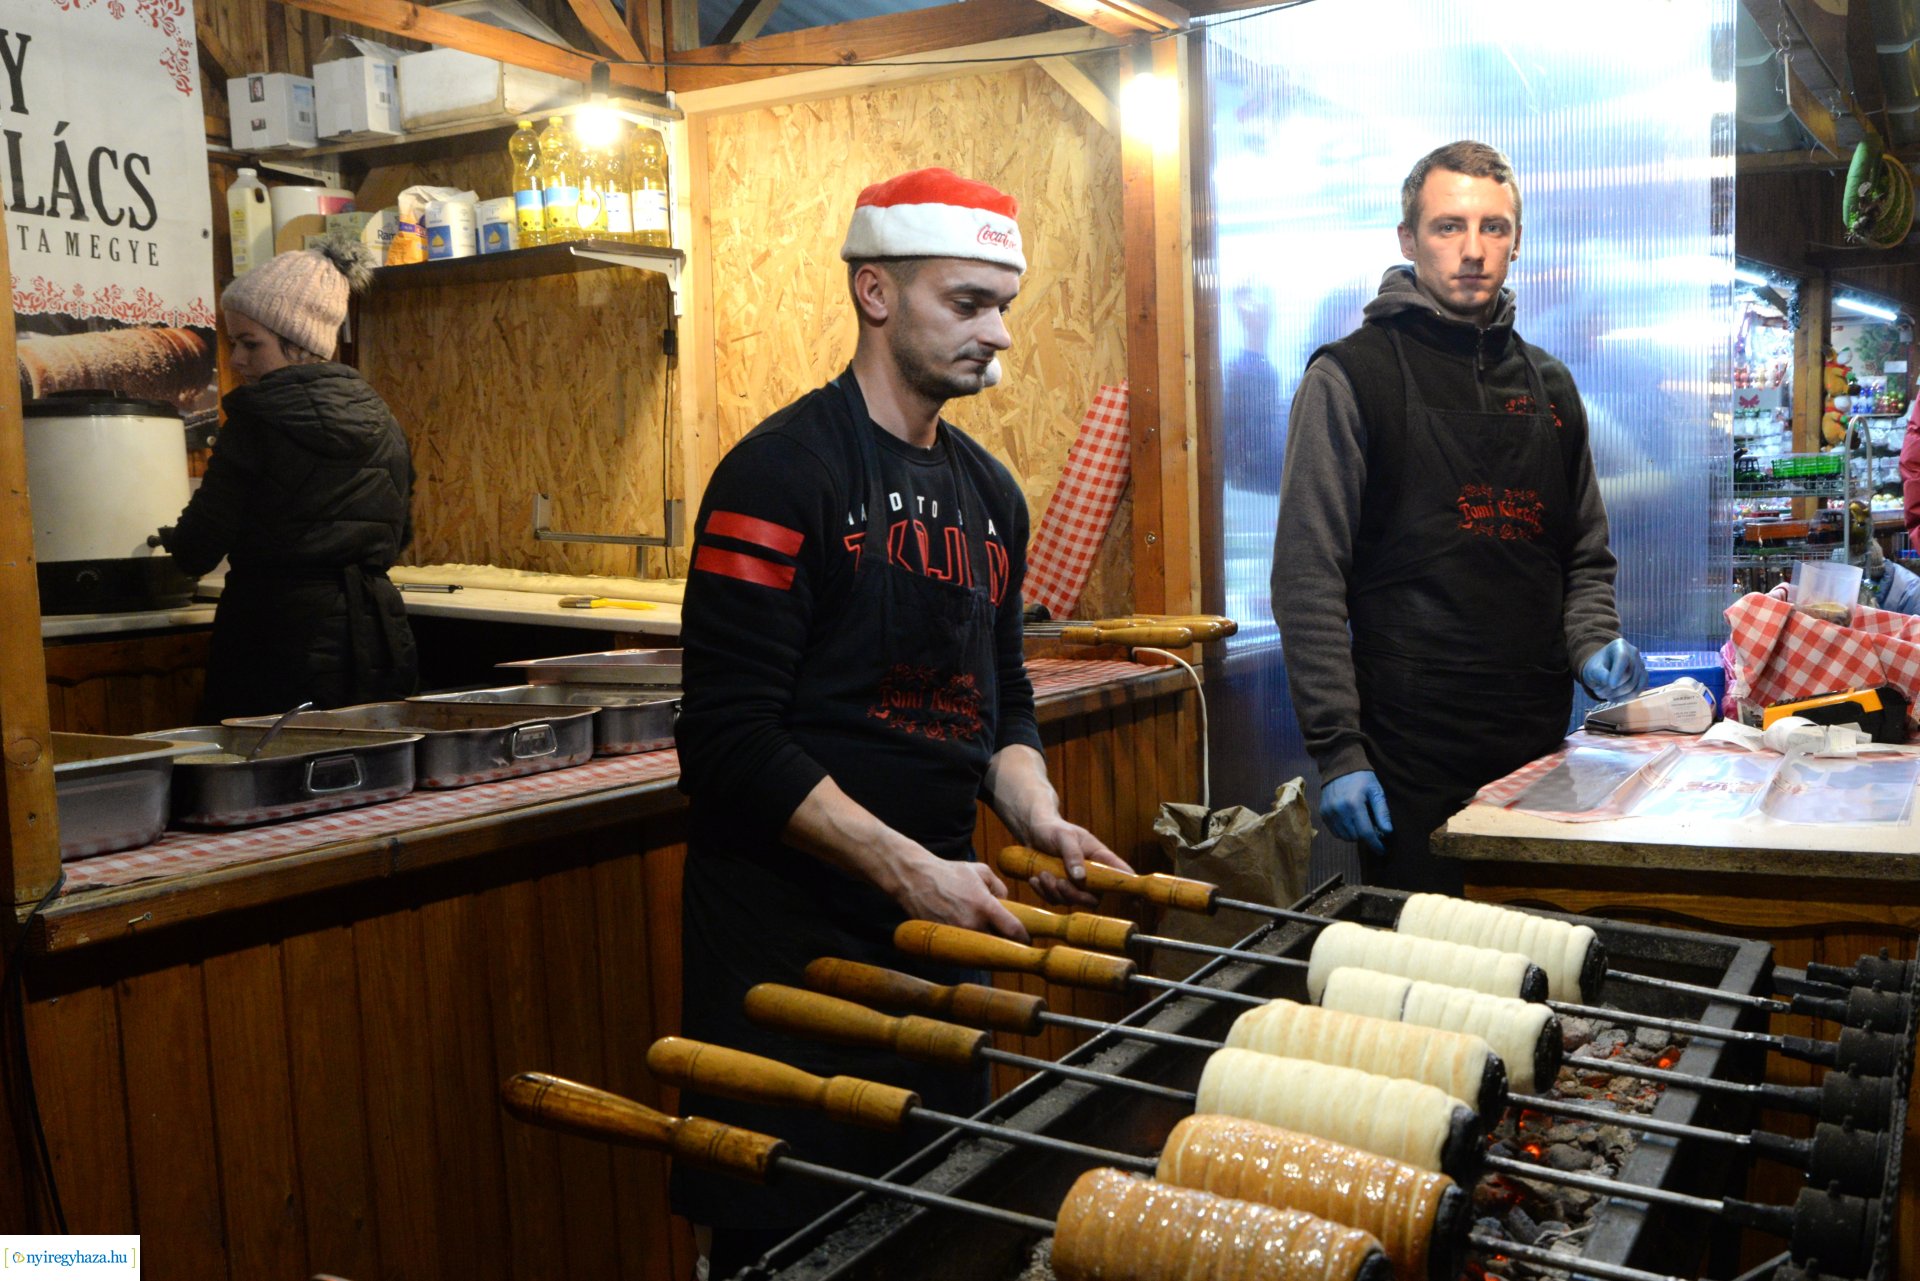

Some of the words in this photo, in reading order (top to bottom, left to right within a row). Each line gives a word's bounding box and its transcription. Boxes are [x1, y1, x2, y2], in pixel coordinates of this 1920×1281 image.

[3, 120, 158, 231] LÁCS
[65, 230, 159, 267] MEGYE
[916, 495, 938, 519] TO
